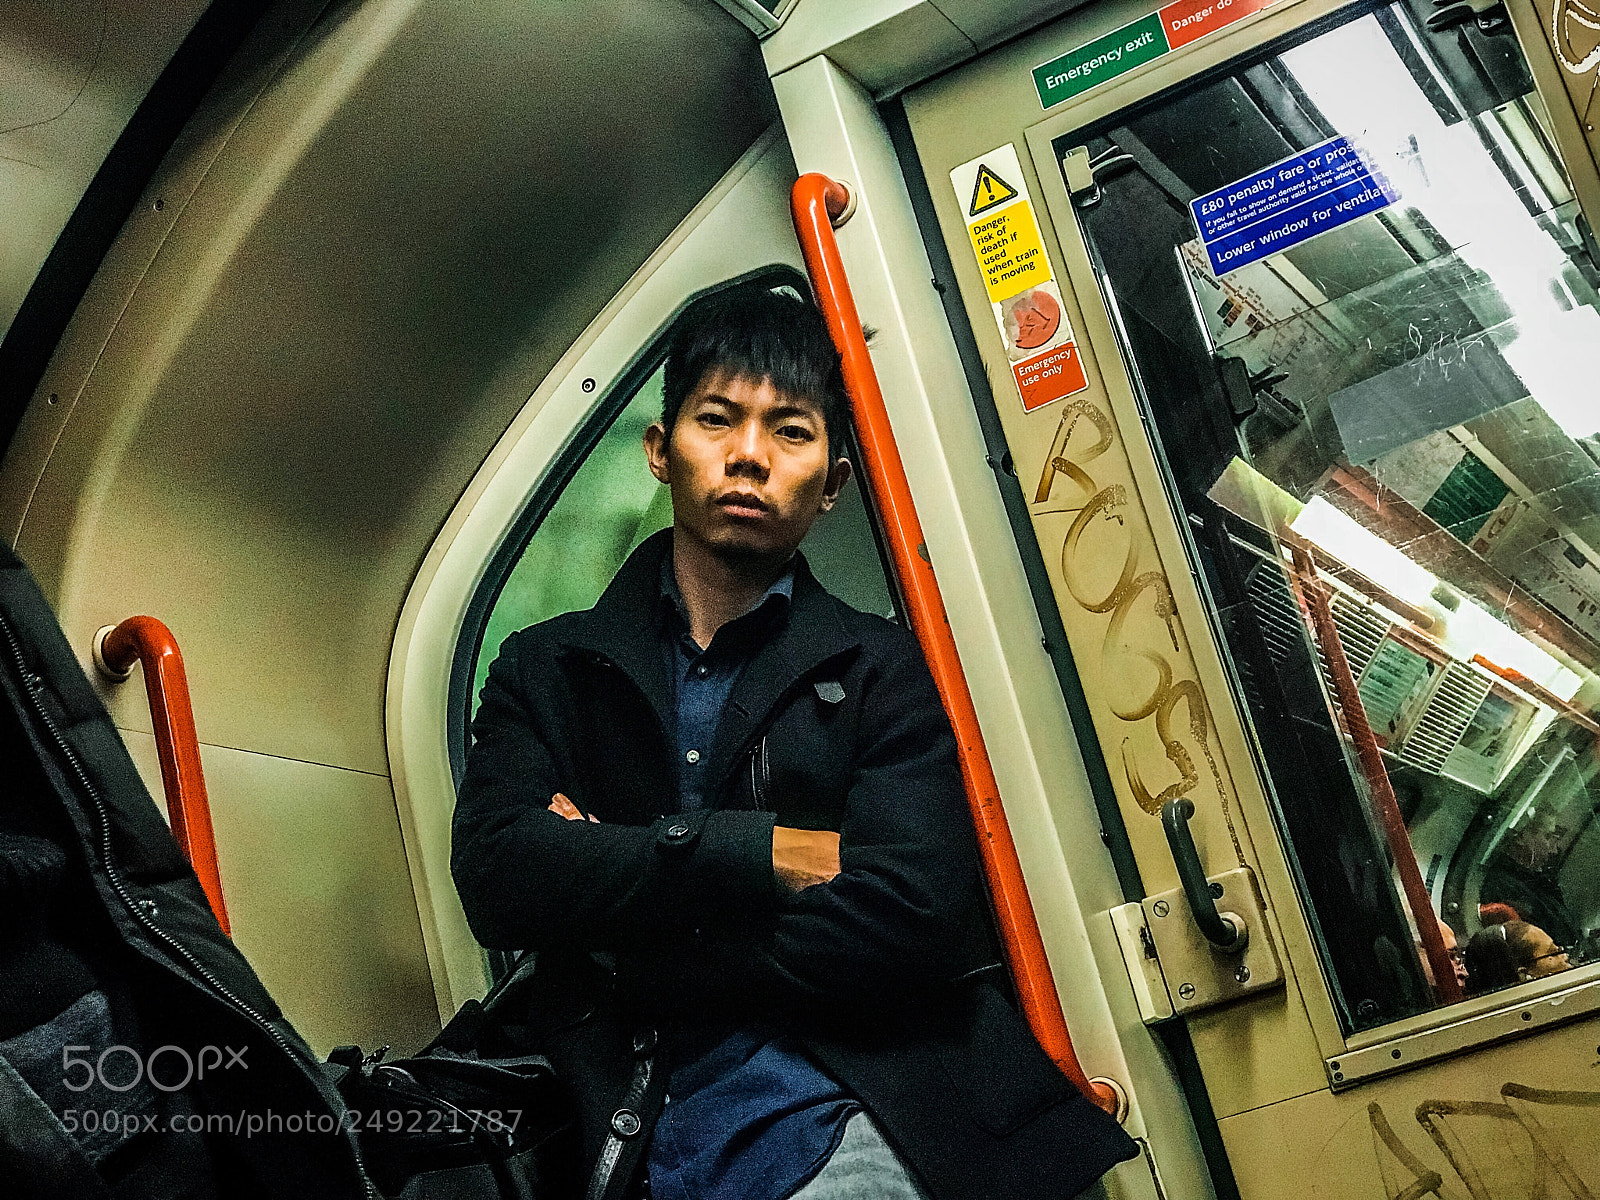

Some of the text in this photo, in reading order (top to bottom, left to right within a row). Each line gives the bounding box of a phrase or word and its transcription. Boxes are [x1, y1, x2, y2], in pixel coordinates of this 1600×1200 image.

[1171, 5, 1213, 31] Danger
[1045, 31, 1154, 90] Emergency exit
[1201, 143, 1354, 216] £80 penalty fare or pros
[1213, 215, 1225, 226] you
[1226, 210, 1238, 219] fail
[1248, 198, 1266, 209] show
[1278, 181, 1306, 196] demand
[1217, 220, 1236, 231] other
[1237, 210, 1257, 222] travel
[1258, 196, 1289, 214] authority
[1290, 189, 1307, 199] valid
[1308, 183, 1319, 192] for
[1320, 178, 1333, 187] the
[1334, 168, 1356, 181] whole
[977, 225, 1007, 246] risk of
[1217, 240, 1256, 263] Lower
[1259, 217, 1309, 245] window
[1312, 208, 1332, 222] for
[1335, 183, 1391, 213] ventilati
[980, 231, 1018, 255] death if
[983, 248, 1007, 265] used
[987, 248, 1039, 275] when train
[989, 261, 1036, 286] is moving
[1018, 349, 1071, 376] Emergency
[1022, 364, 1062, 387] use only
